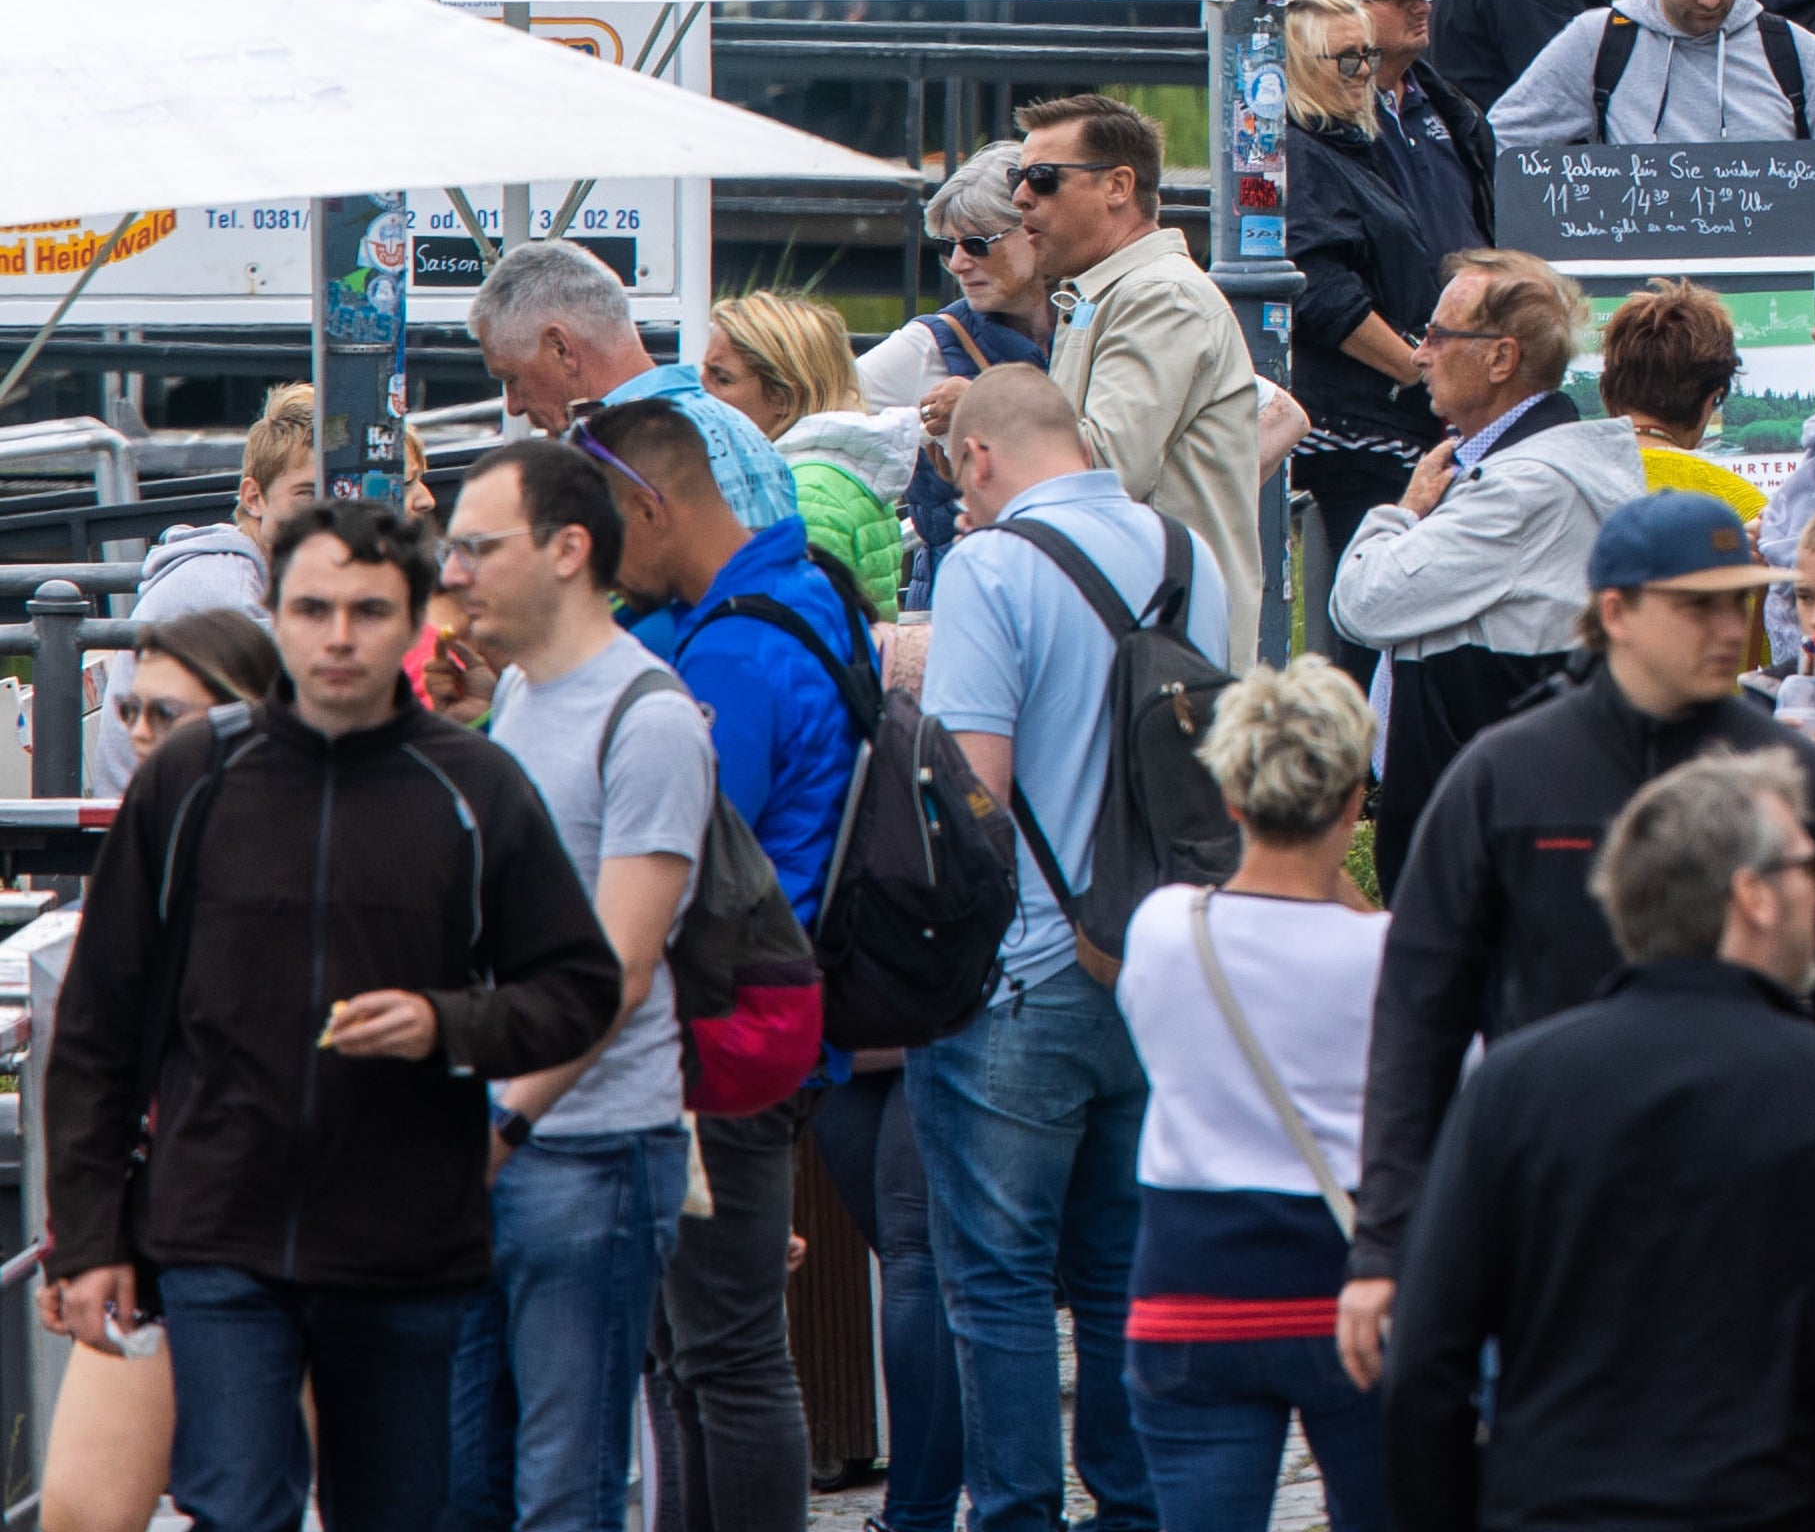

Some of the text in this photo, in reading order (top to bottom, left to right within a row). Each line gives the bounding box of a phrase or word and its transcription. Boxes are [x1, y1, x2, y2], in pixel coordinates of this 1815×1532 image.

[1518, 150, 1552, 177] Wir
[1561, 155, 1621, 185] fahren
[1629, 153, 1659, 187] für
[1669, 151, 1704, 179] Sie
[1739, 188, 1774, 213] Uhr
[205, 209, 245, 230] Tel.
[252, 209, 311, 231] 0381/
[430, 209, 461, 230] od.
[584, 210, 609, 229] 02
[616, 210, 641, 229] 26
[1612, 220, 1642, 244] gibt
[1666, 223, 1689, 234] an
[1691, 218, 1737, 236] Bord
[1732, 461, 1797, 474] HRTEN
